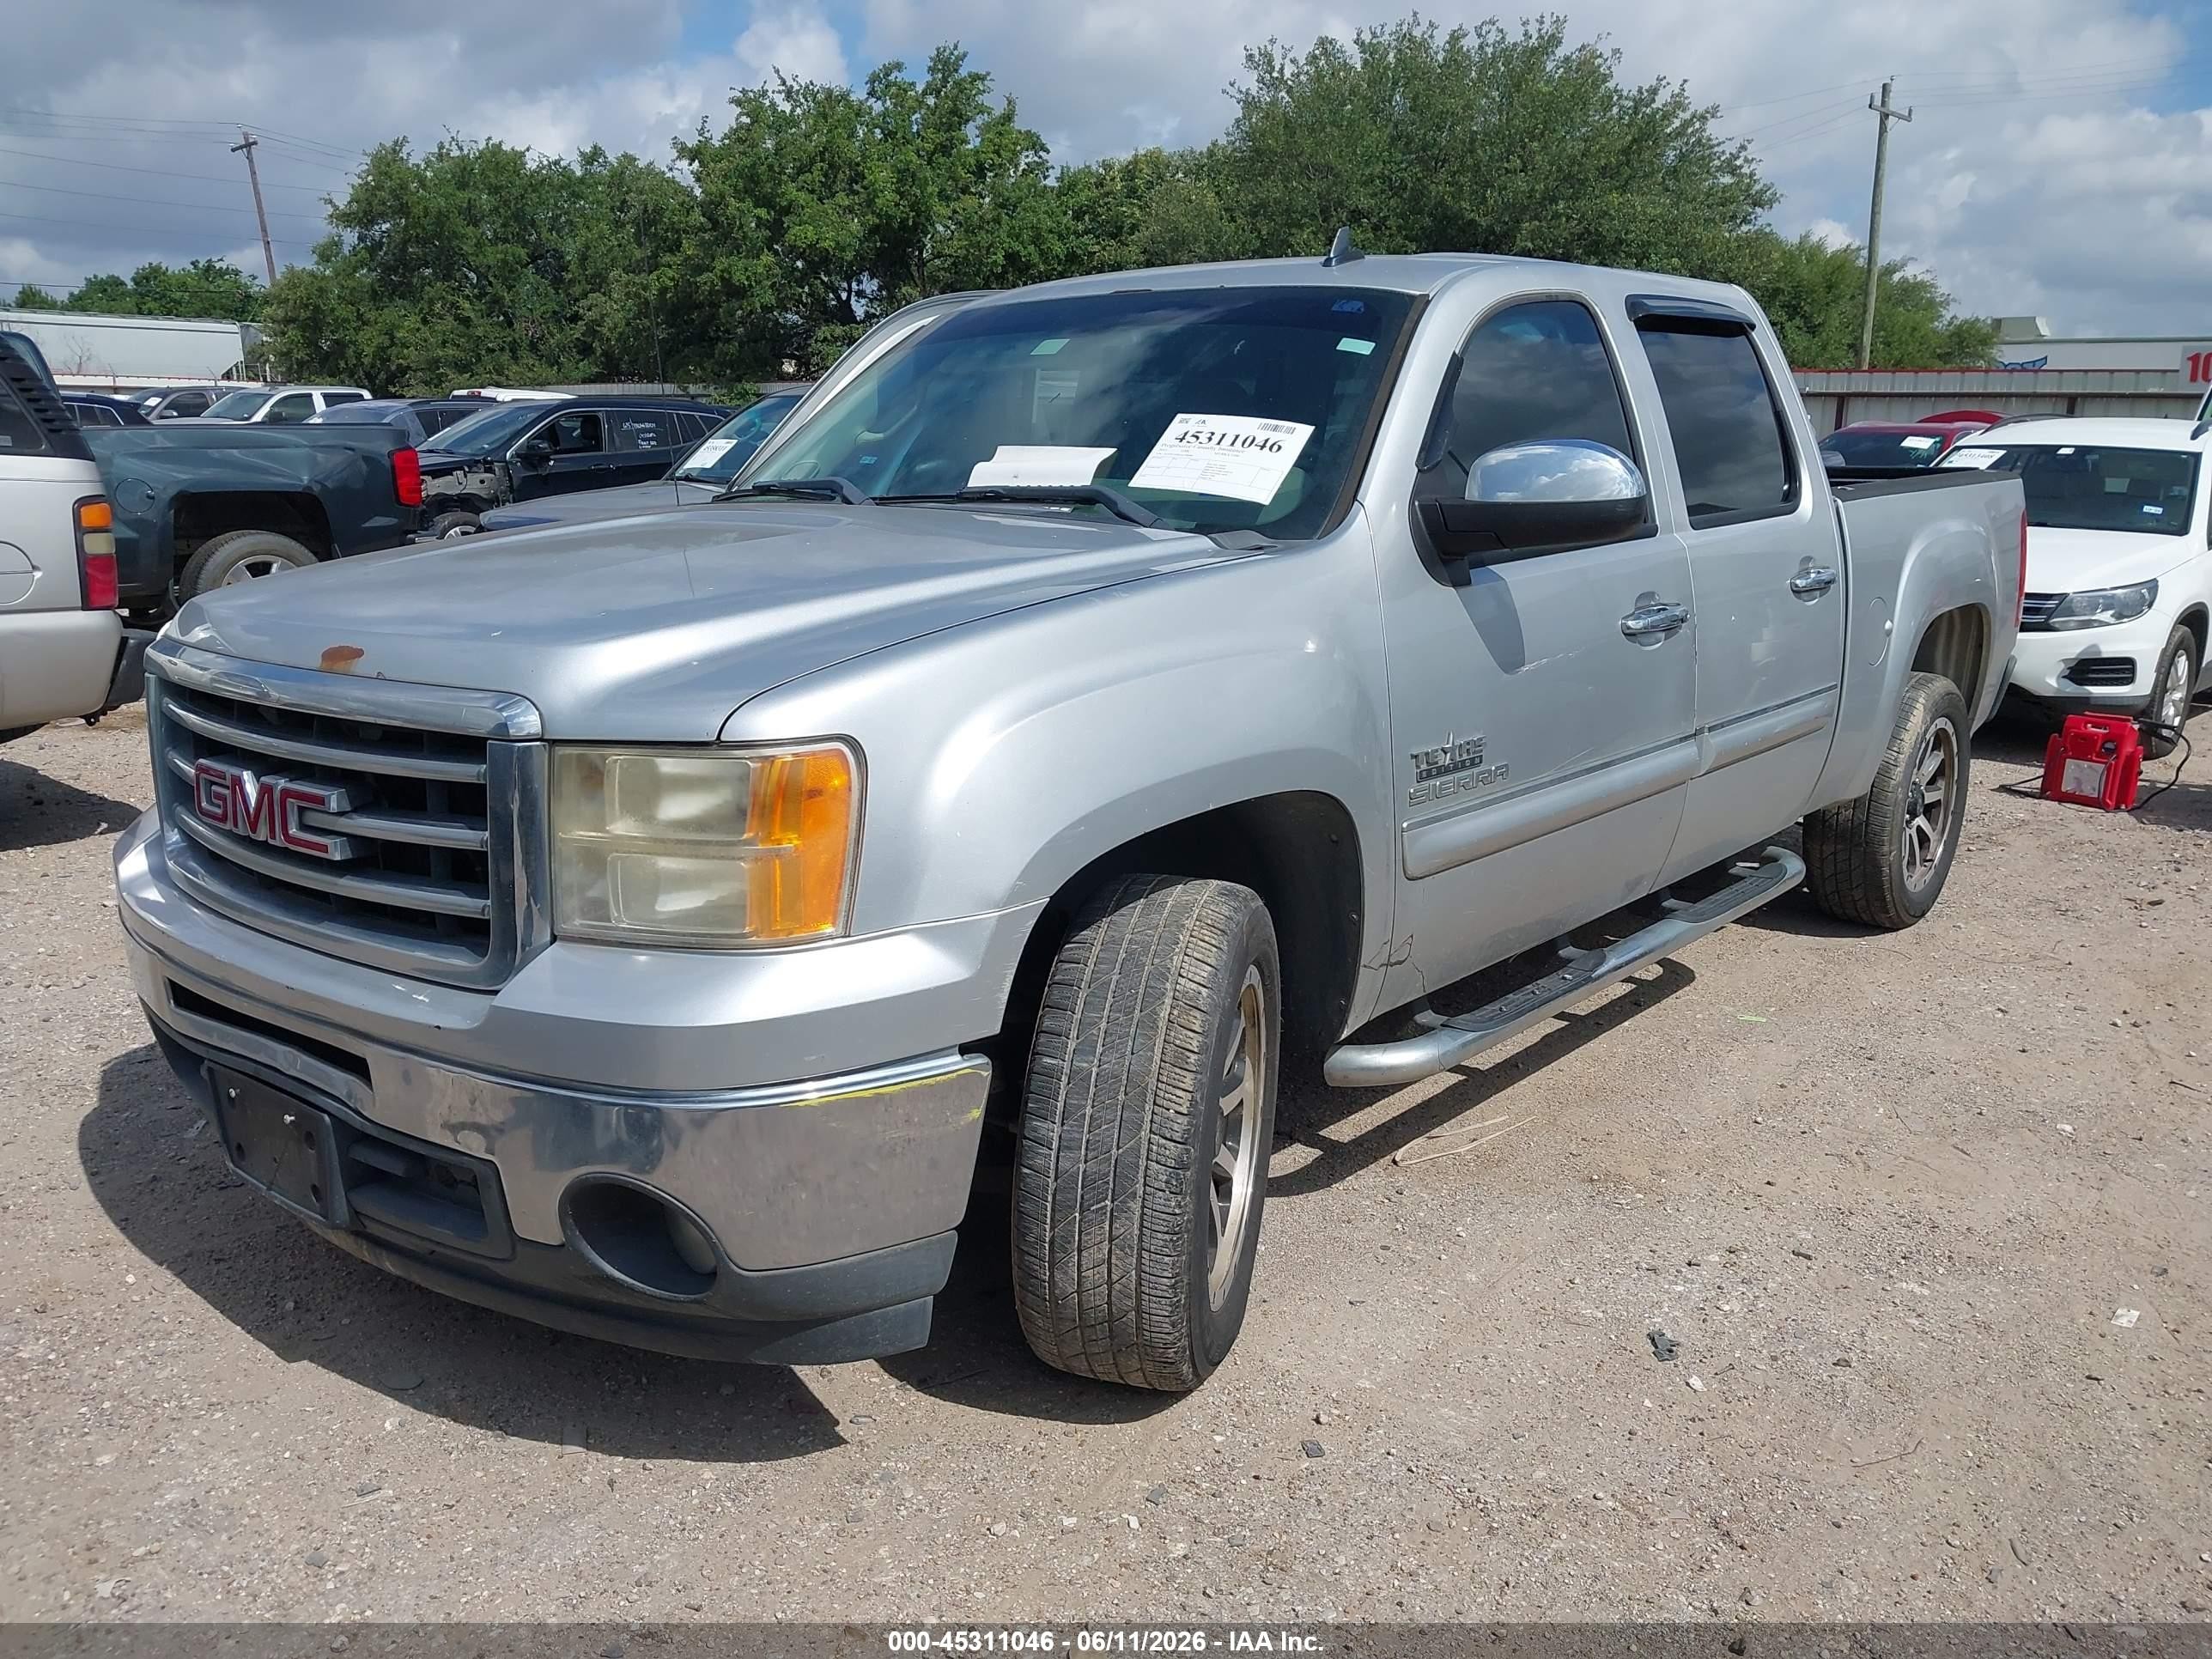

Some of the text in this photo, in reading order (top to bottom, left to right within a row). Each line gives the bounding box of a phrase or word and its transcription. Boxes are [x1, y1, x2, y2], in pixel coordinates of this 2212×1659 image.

[1174, 429, 1285, 454] 45311046
[1410, 731, 1487, 769] TEXAS
[1420, 757, 1481, 779] EDITION
[1408, 763, 1510, 808] SIERRA
[194, 757, 353, 860] GMC
